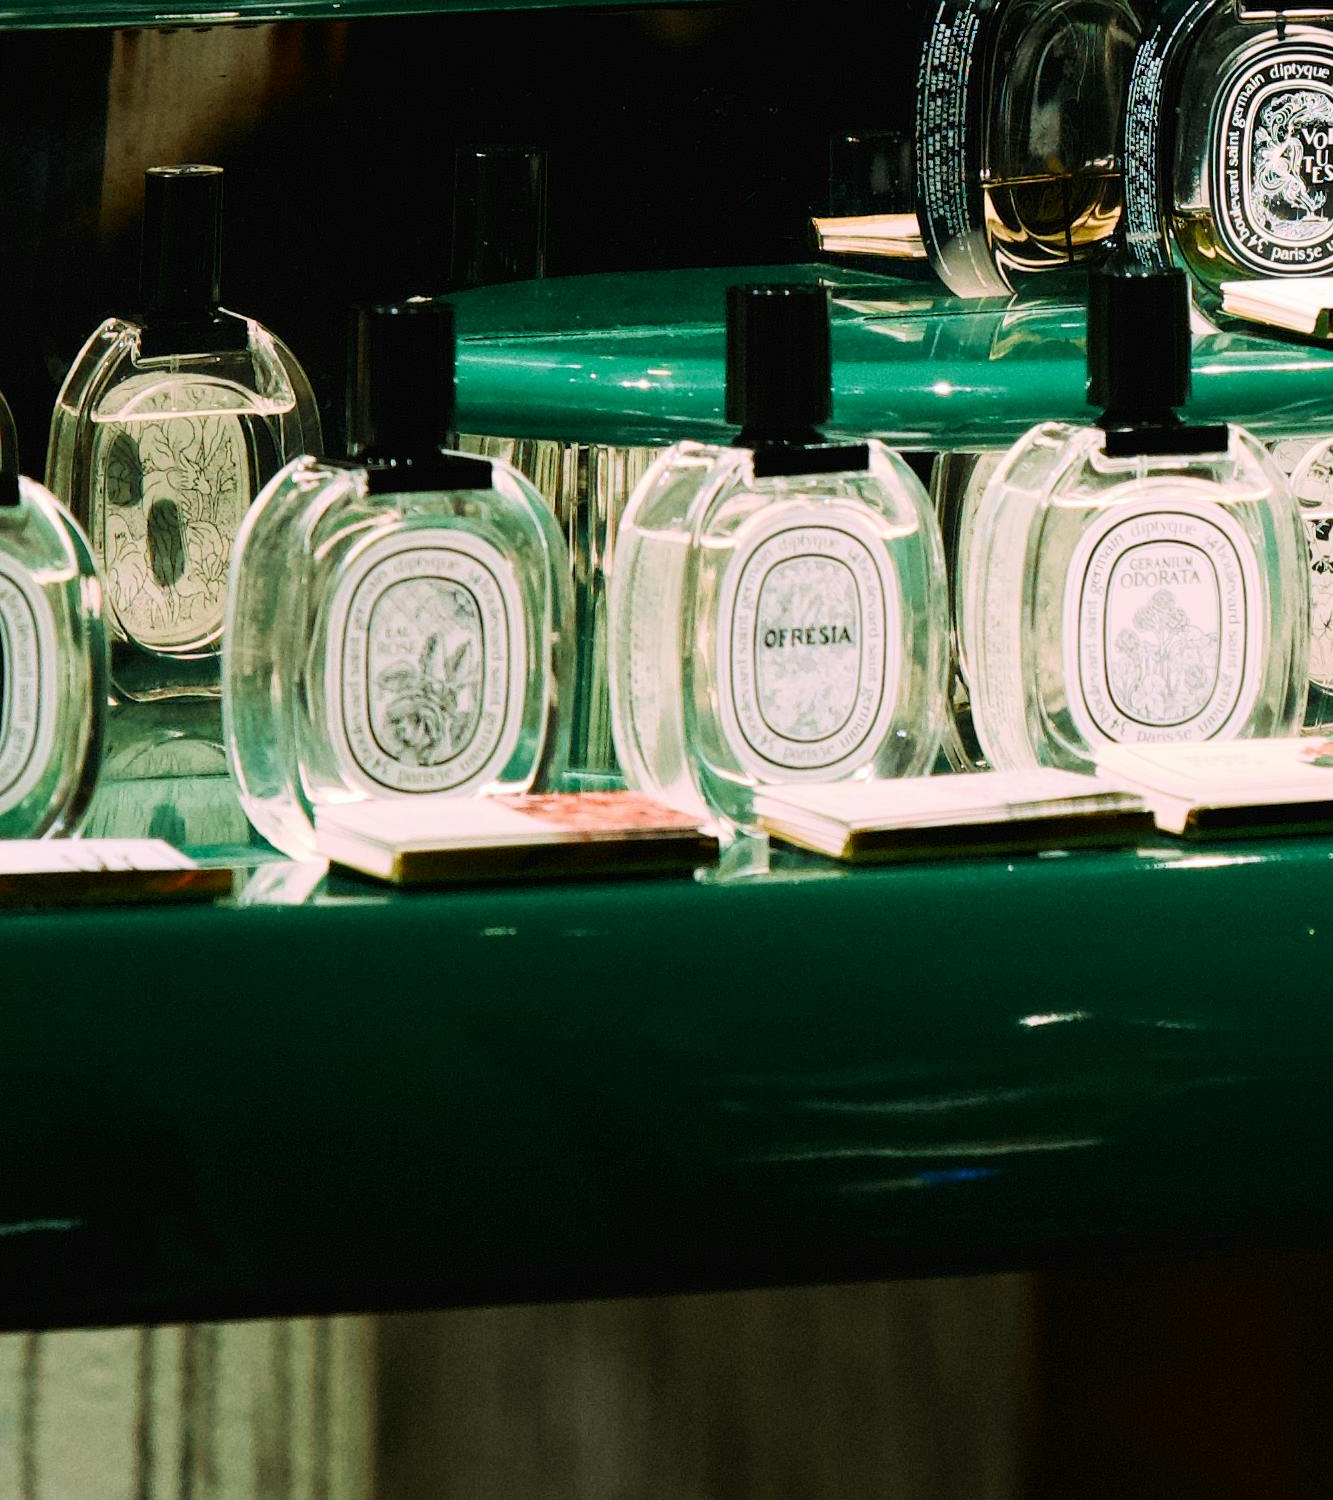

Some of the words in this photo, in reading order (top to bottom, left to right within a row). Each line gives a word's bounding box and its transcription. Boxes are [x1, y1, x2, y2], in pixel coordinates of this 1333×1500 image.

[1269, 63, 1330, 81] diptyque
[1232, 75, 1265, 128] germain
[1228, 131, 1239, 166] saint
[1131, 521, 1197, 539] diptyque
[1090, 533, 1125, 596] germain
[1120, 570, 1201, 589] ODORATA
[1198, 672, 1234, 732] germain
